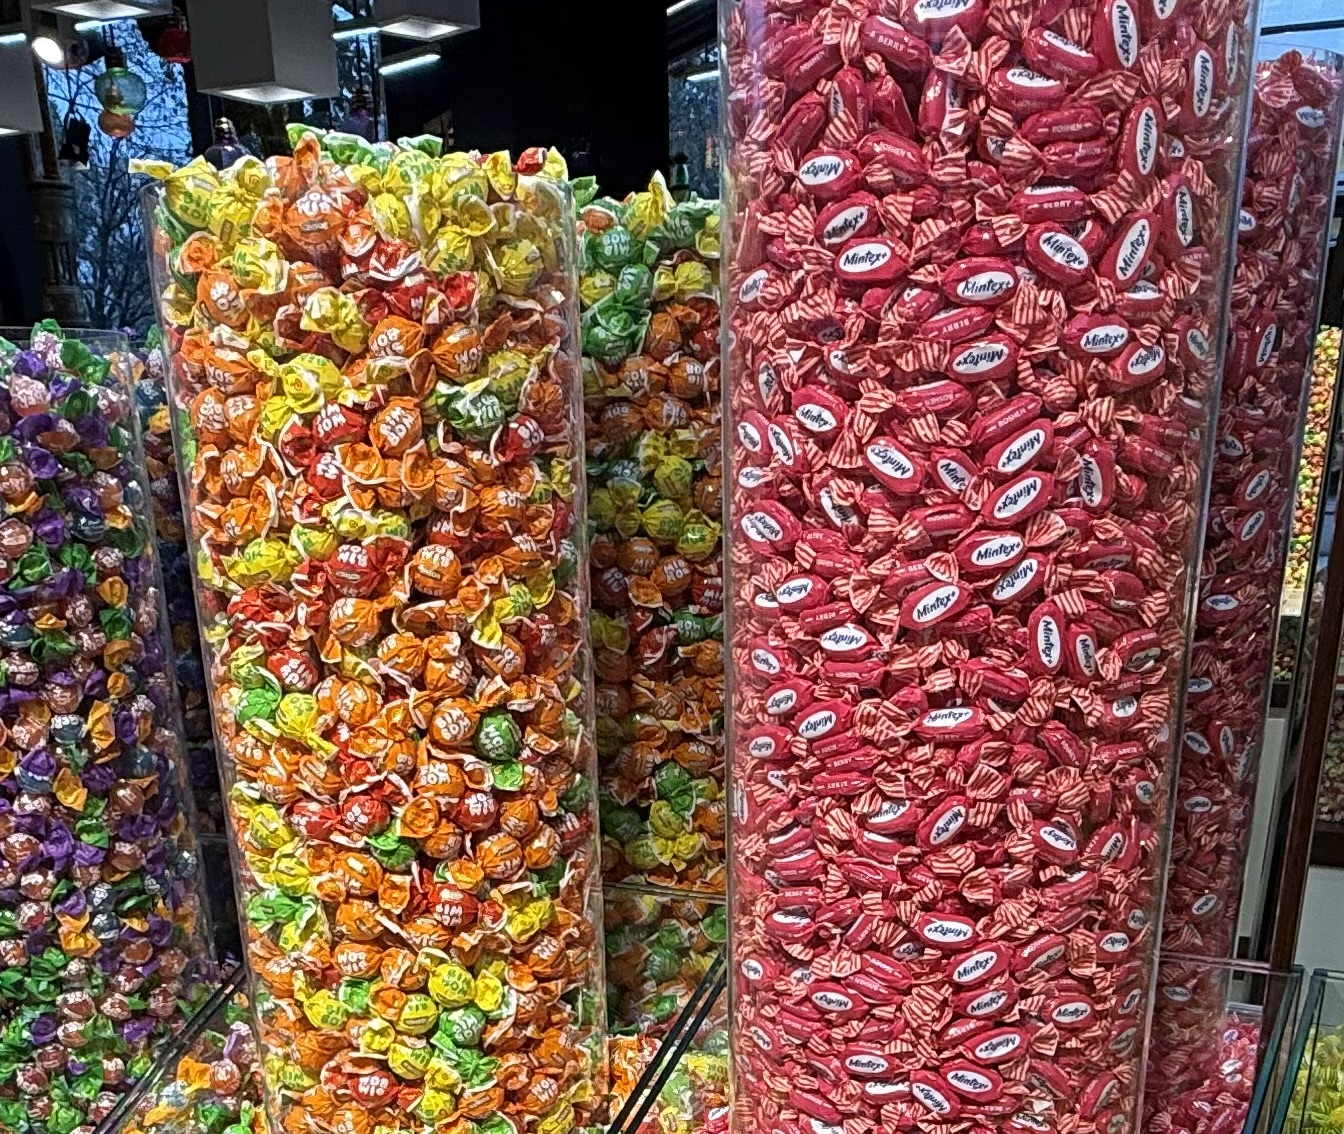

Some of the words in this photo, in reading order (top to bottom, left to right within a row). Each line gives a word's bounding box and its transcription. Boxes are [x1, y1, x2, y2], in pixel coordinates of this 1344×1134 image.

[878, 33, 905, 51] BERRY
[1118, 5, 1131, 63] Mintex+
[843, 249, 890, 267] Mintex+
[1043, 233, 1085, 267] Mintex+
[1118, 223, 1146, 277] Mintex+
[962, 278, 1011, 295] Mintex+
[1083, 330, 1125, 348] Mintex+
[996, 407, 1027, 428] ROSHEN
[1001, 433, 1041, 470] Mintex+
[976, 542, 1021, 559] Mintex+
[916, 592, 957, 619] Mintex+
[957, 955, 995, 980] Mintex+
[849, 1058, 886, 1070] Mintex+
